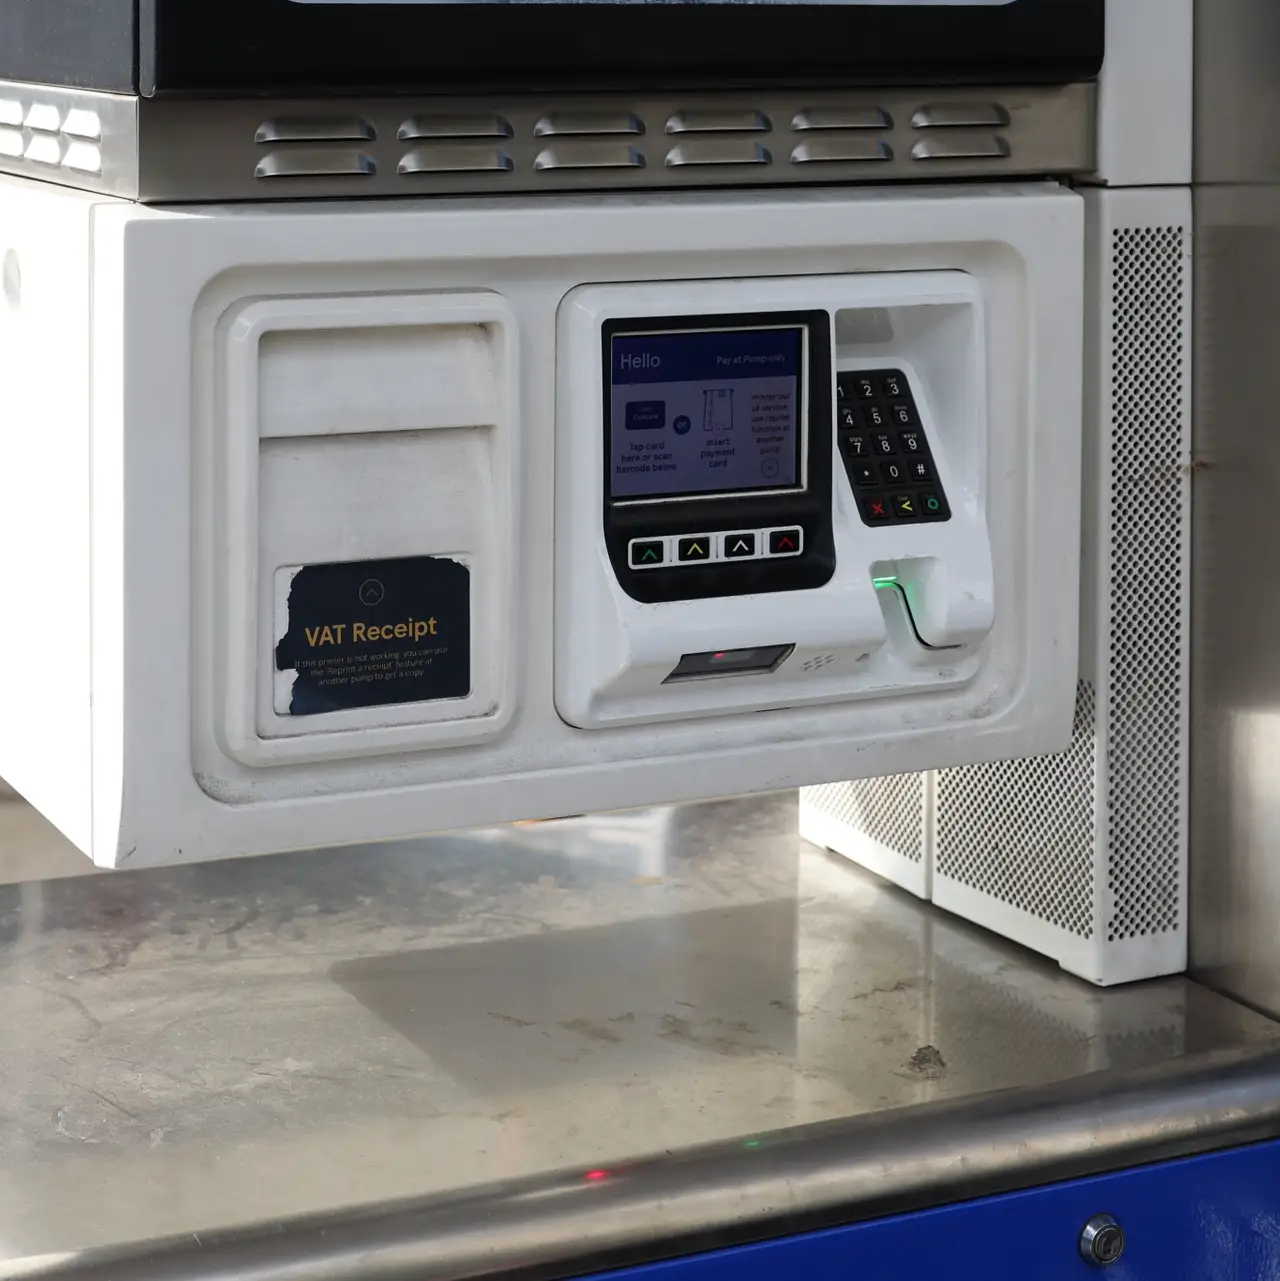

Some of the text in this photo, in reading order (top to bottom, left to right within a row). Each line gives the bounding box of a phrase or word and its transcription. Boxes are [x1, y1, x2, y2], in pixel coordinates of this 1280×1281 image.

[621, 353, 660, 369] Hello
[717, 353, 786, 366] Pay at Pump only
[837, 383, 899, 396] 1 2 3
[846, 411, 908, 425] 4 5 6
[677, 421, 688, 430] or
[629, 442, 665, 452] Tap card
[854, 438, 917, 454] 7 8 9
[621, 453, 641, 463] here
[654, 453, 673, 461] scan
[700, 448, 735, 458] payment
[616, 463, 678, 474] barcode below
[709, 459, 727, 468] card
[890, 466, 899, 477] 0
[305, 617, 438, 647] VAT Receipt
[301, 646, 448, 669] this printer not you can use
[310, 657, 433, 677] the feature at
[318, 676, 349, 686] another
[351, 674, 373, 684] pump
[385, 671, 397, 681] get
